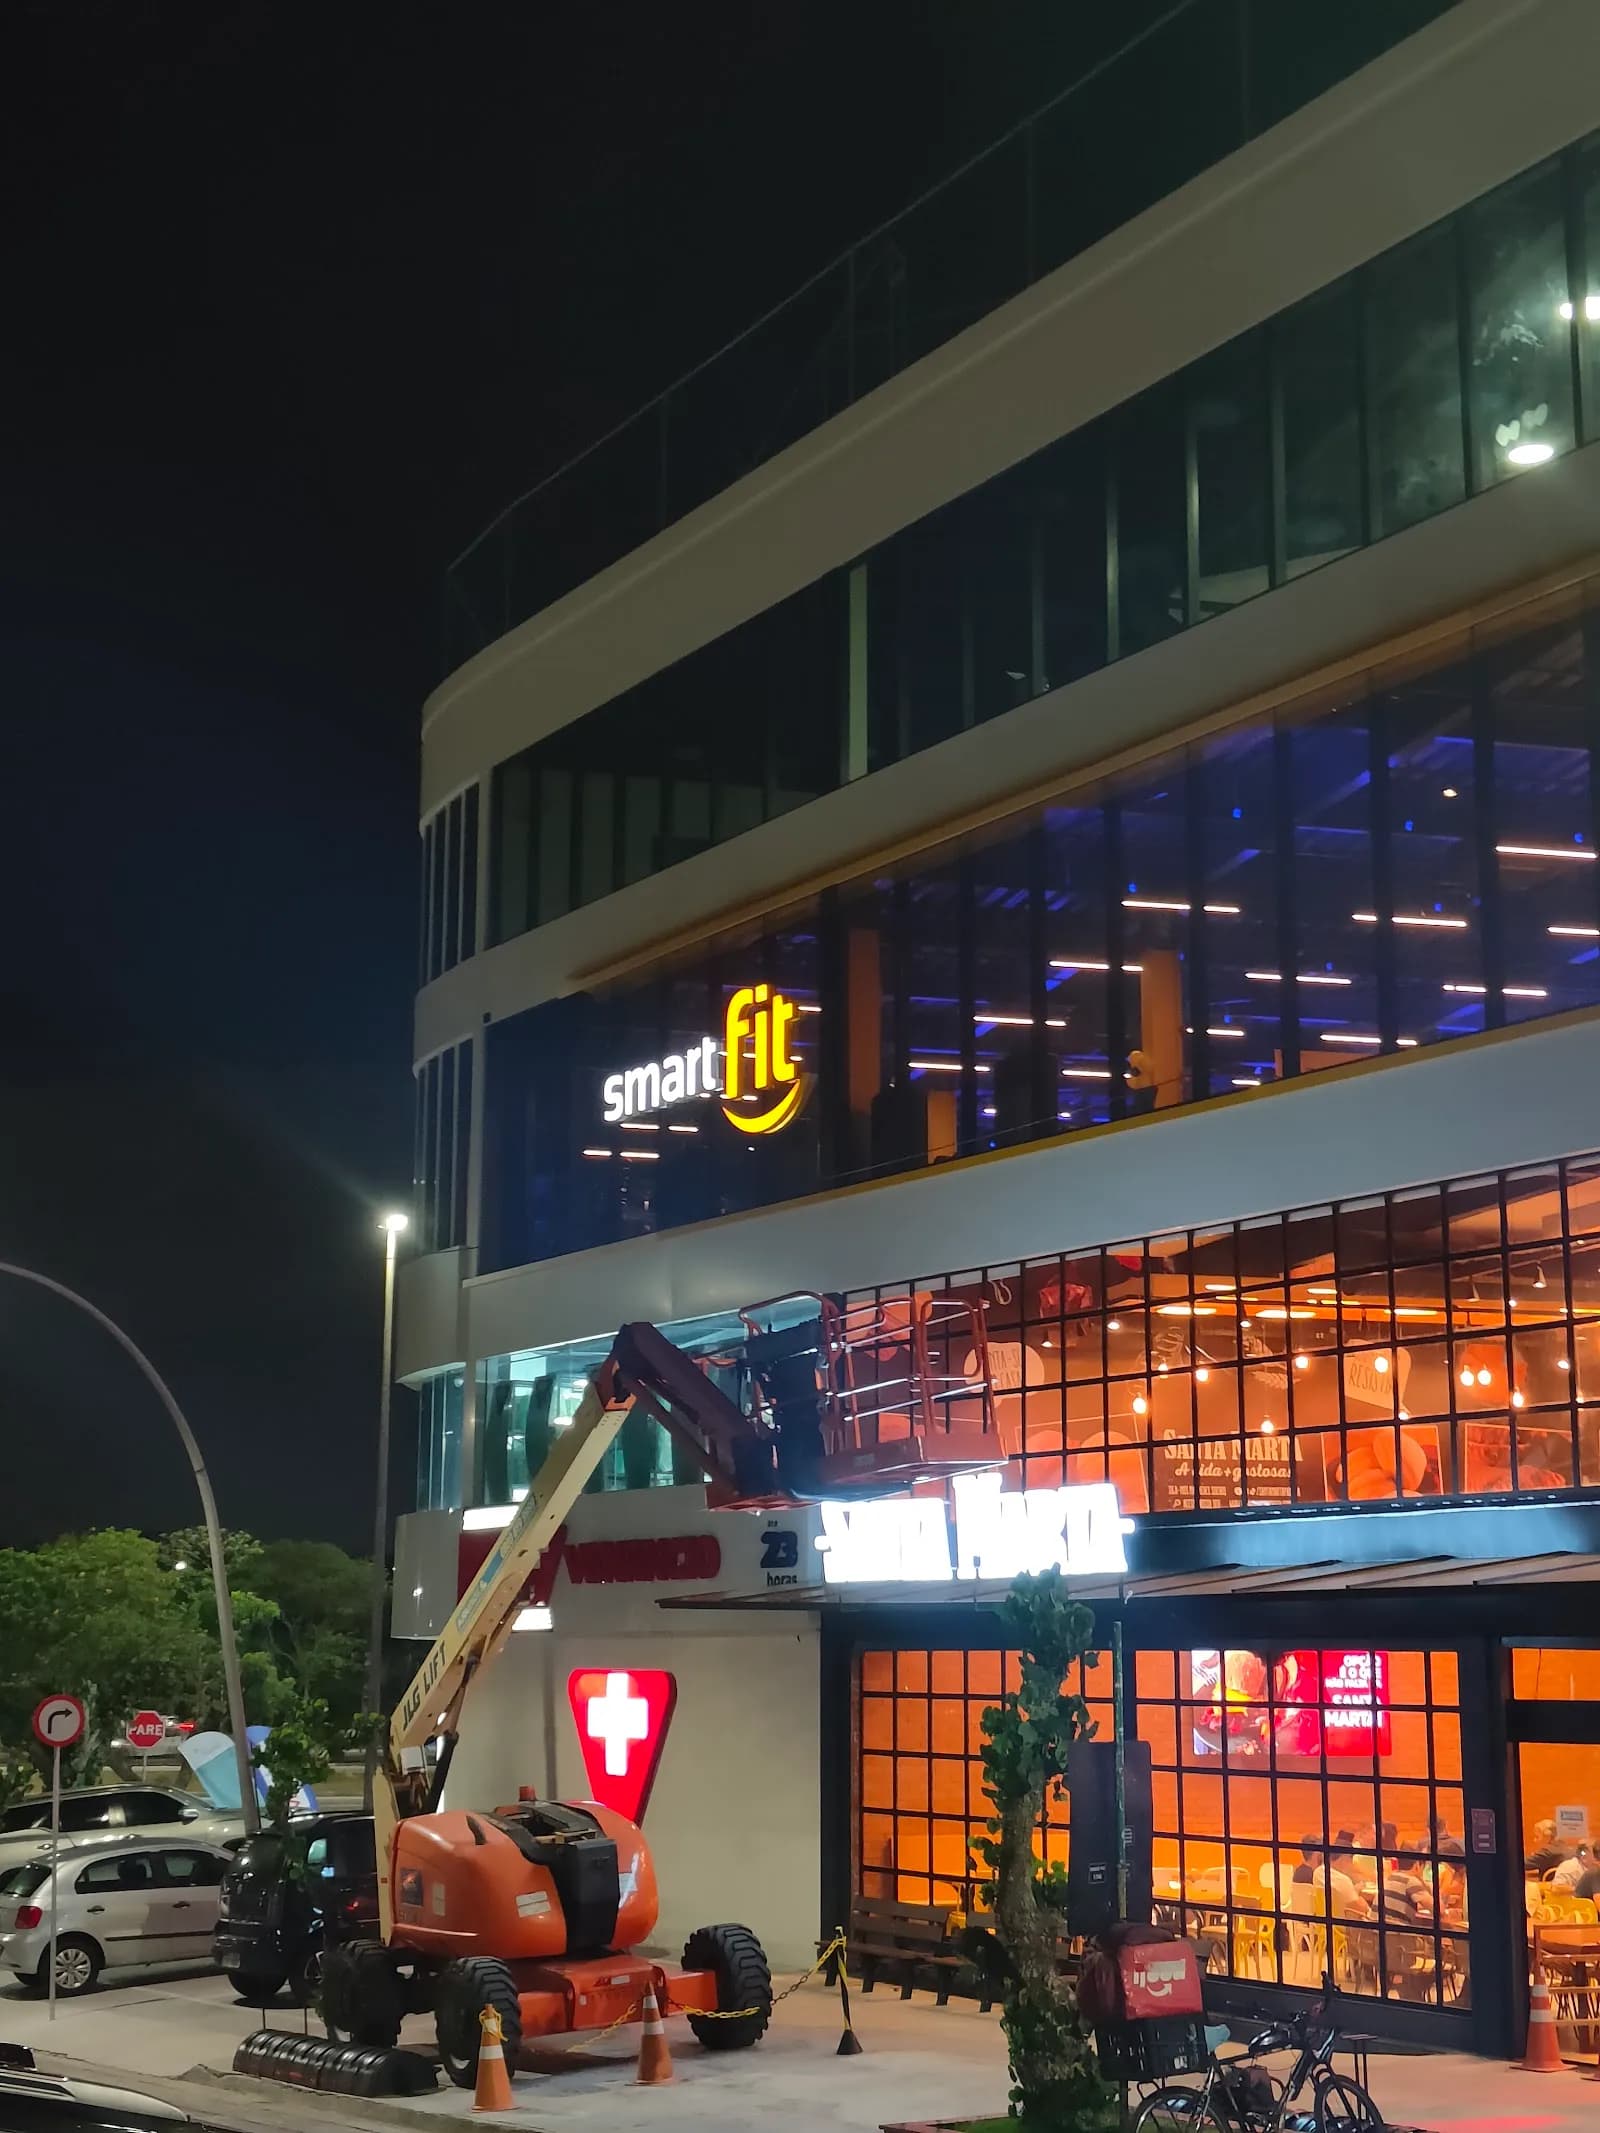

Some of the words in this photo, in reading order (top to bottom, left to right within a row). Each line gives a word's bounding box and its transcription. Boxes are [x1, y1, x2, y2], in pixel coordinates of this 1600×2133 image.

[1191, 1463, 1223, 1477] ida
[766, 1571, 798, 1587] horas
[402, 1685, 422, 1731] JLG
[424, 1645, 447, 1696] LIFT
